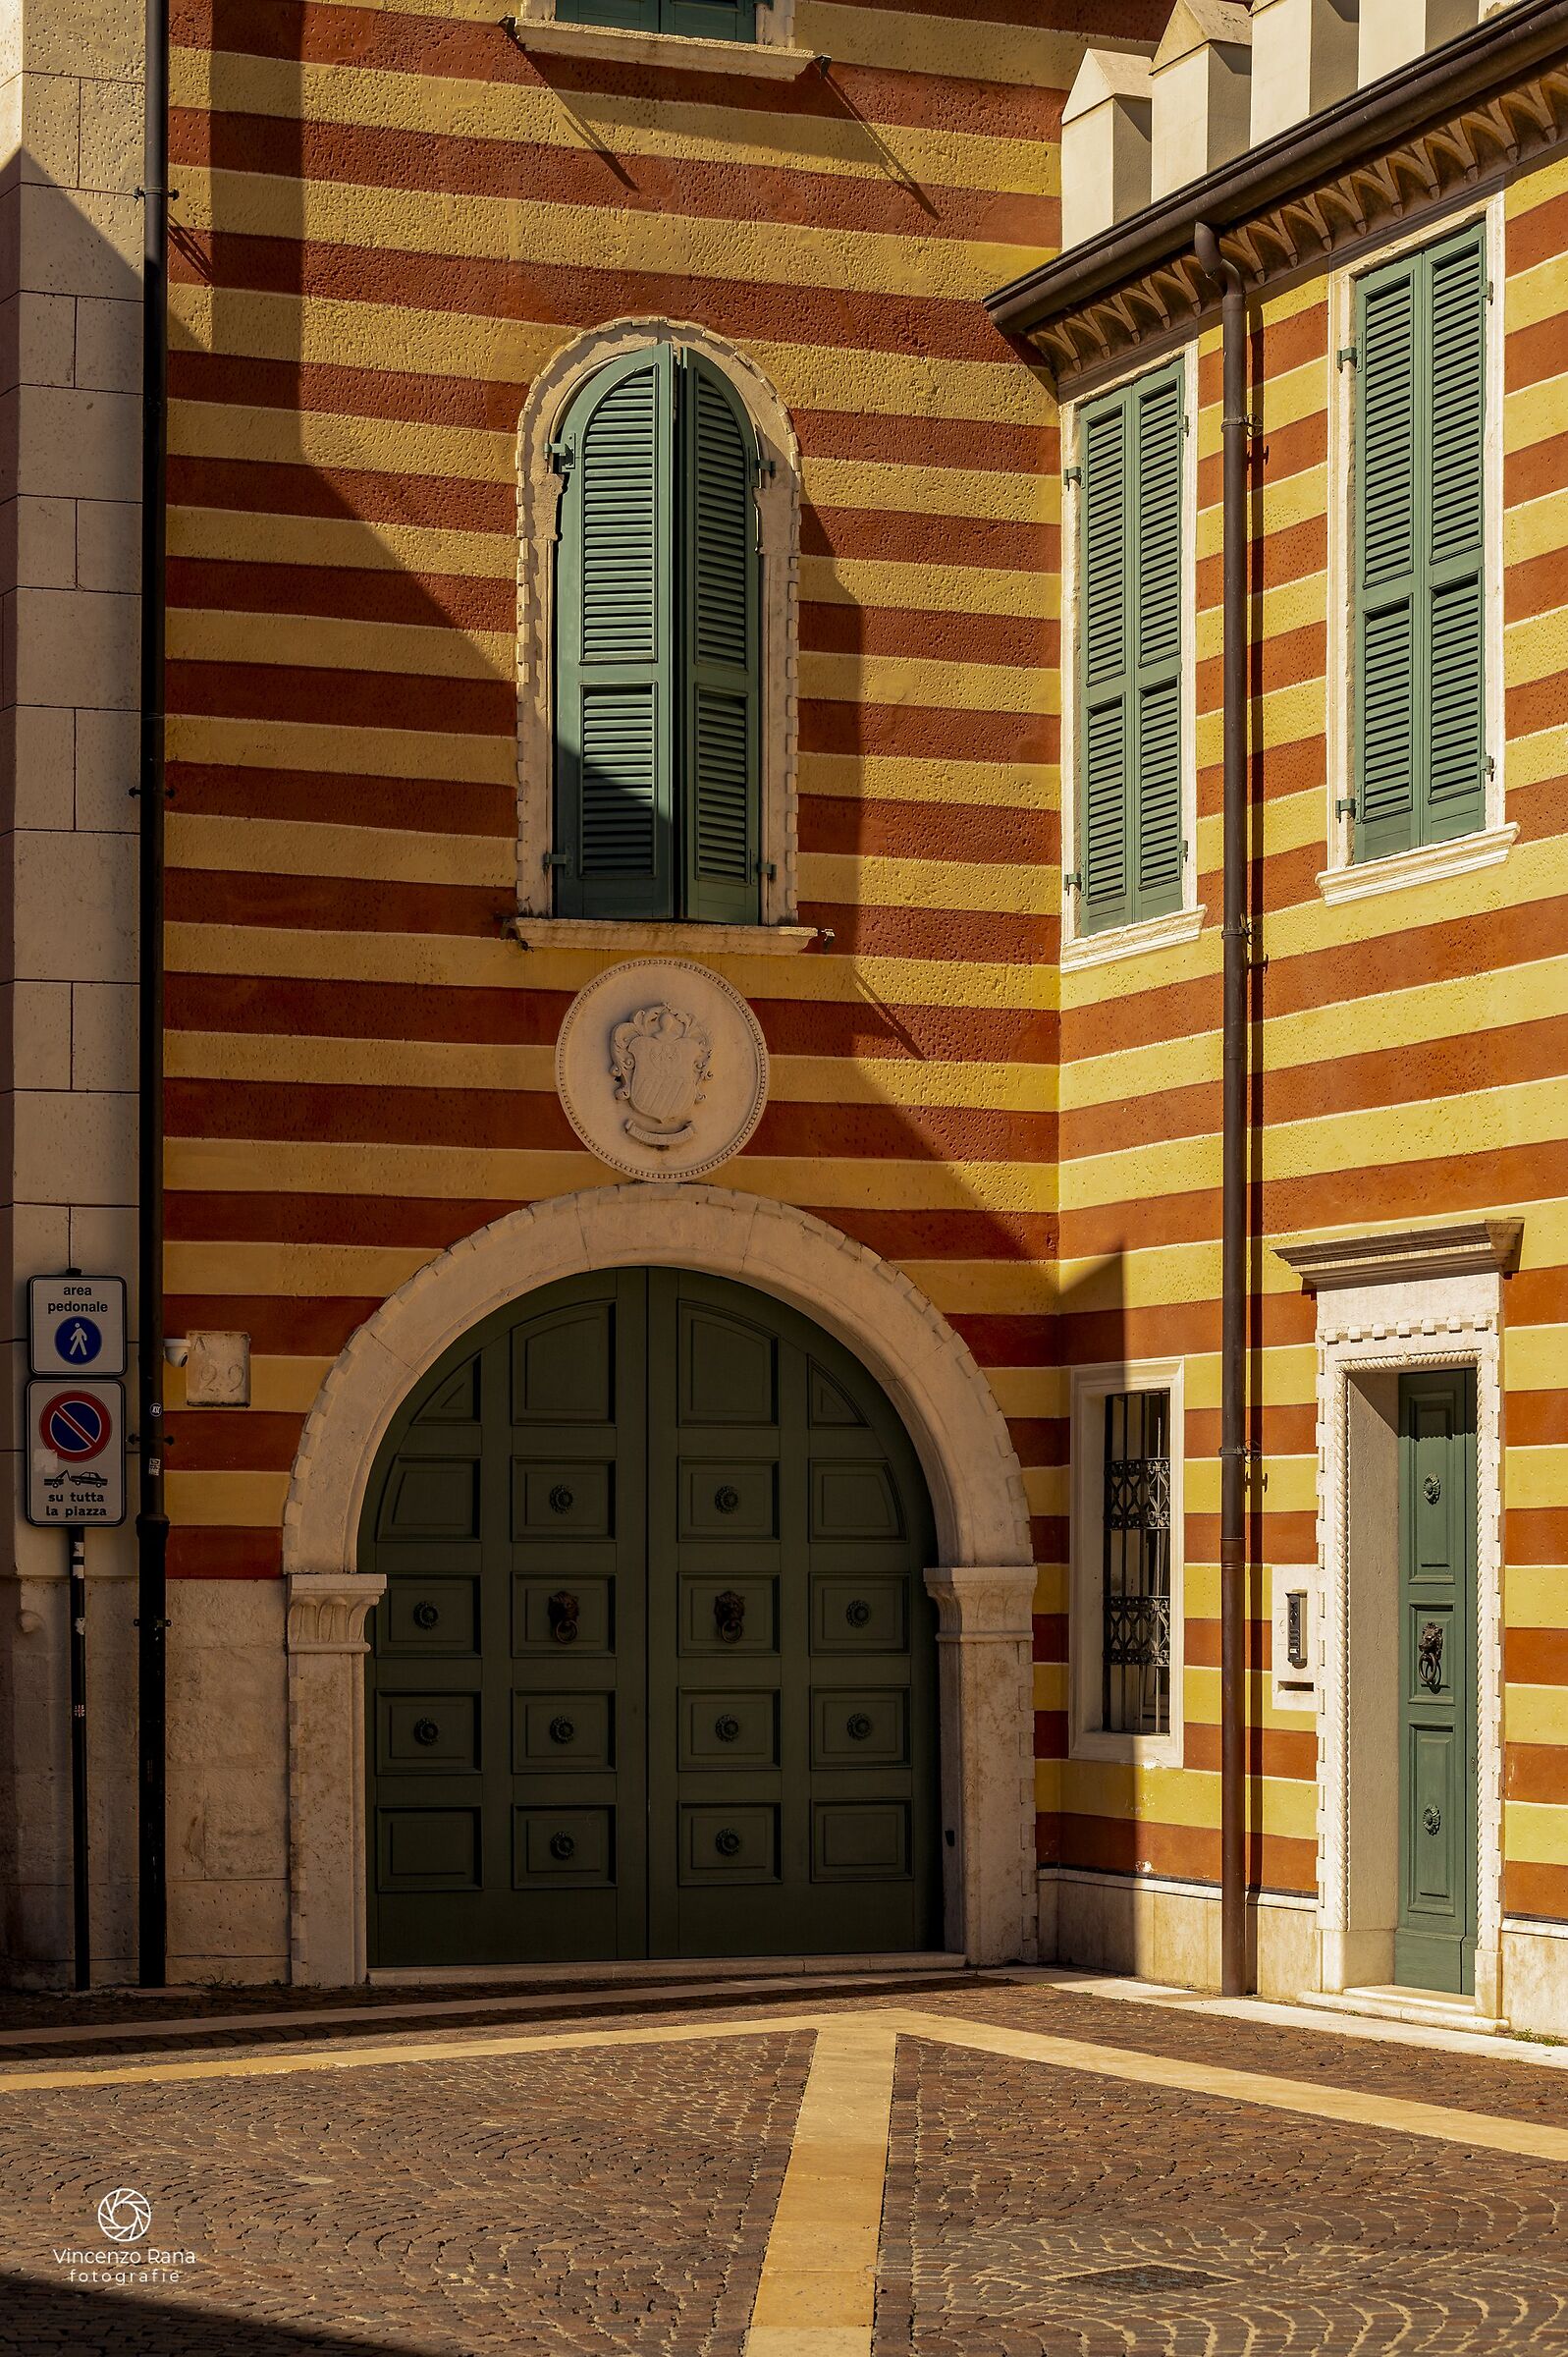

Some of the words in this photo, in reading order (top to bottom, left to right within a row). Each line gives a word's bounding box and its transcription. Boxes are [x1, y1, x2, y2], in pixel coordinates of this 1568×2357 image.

[63, 1287, 92, 1295] area
[48, 1301, 108, 1314] pedonale
[48, 1493, 64, 1502] su
[70, 1492, 104, 1503] tutta
[46, 1506, 59, 1516] la
[65, 1506, 107, 1517] piazza
